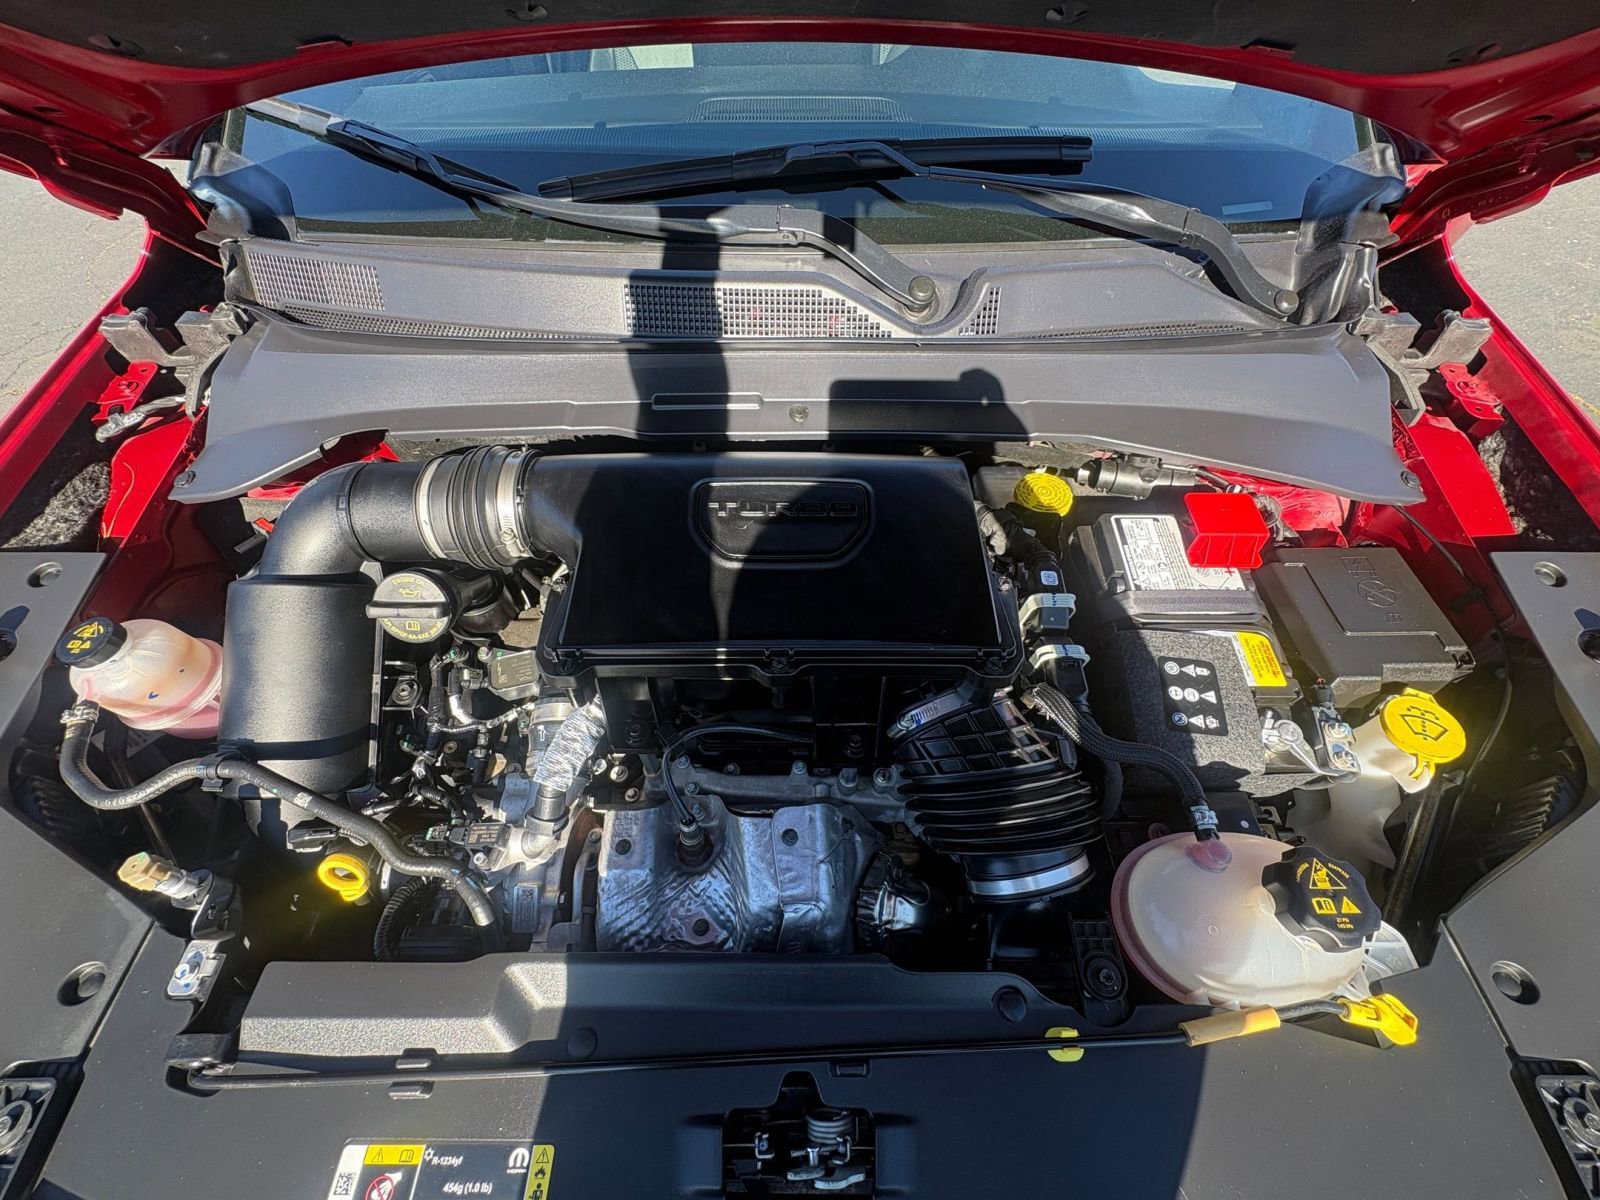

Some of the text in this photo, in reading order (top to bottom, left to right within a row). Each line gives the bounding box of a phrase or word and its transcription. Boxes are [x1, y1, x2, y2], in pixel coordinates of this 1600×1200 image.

[708, 502, 858, 517] TURBO
[391, 576, 426, 587] ENGINE OIL
[431, 1155, 464, 1167] R-1234yf
[442, 1181, 493, 1195] 454g (1.0 lb)
